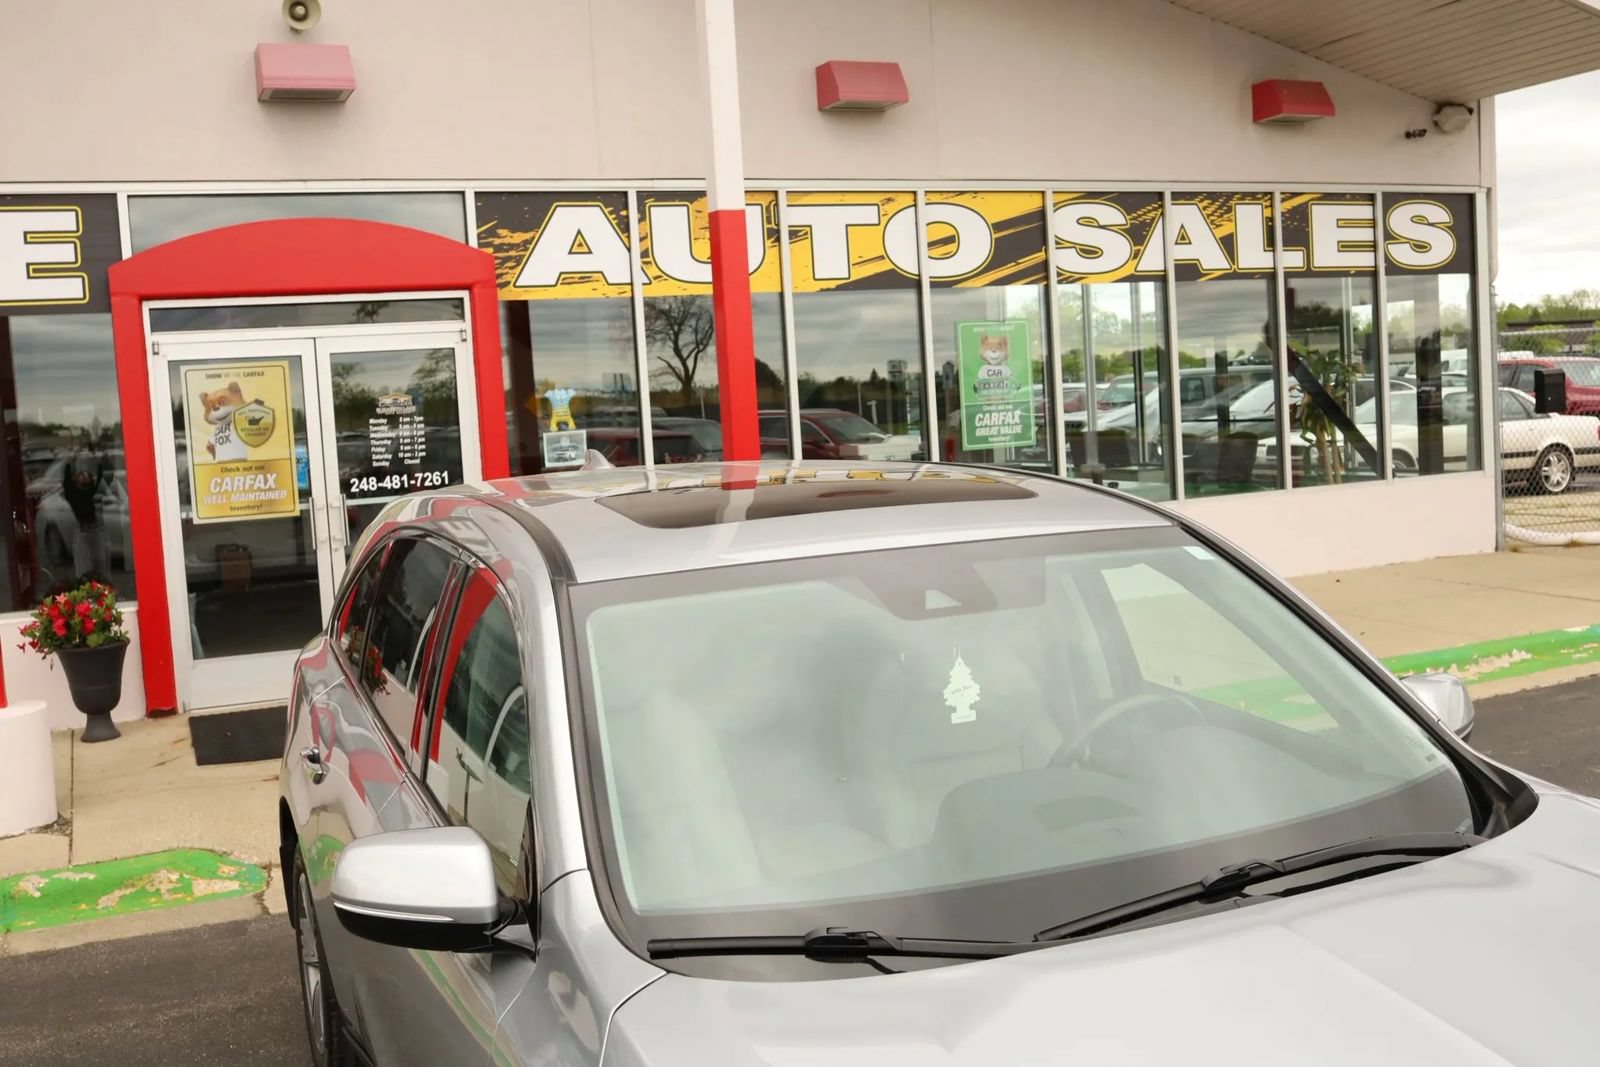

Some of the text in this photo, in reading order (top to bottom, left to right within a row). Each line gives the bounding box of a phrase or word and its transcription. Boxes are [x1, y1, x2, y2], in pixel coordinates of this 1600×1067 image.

[513, 202, 994, 288] AUTO
[1053, 200, 1457, 275] SALES
[987, 369, 1003, 378] CAR
[975, 410, 1021, 427] CARFAX
[976, 425, 1023, 436] GREAT VALUE
[221, 466, 240, 474] Check
[210, 473, 278, 493] CARFAX
[350, 470, 449, 492] 248-481-7261
[204, 490, 288, 504] WELL MAINTAINED
[229, 504, 263, 512] Inventory!
